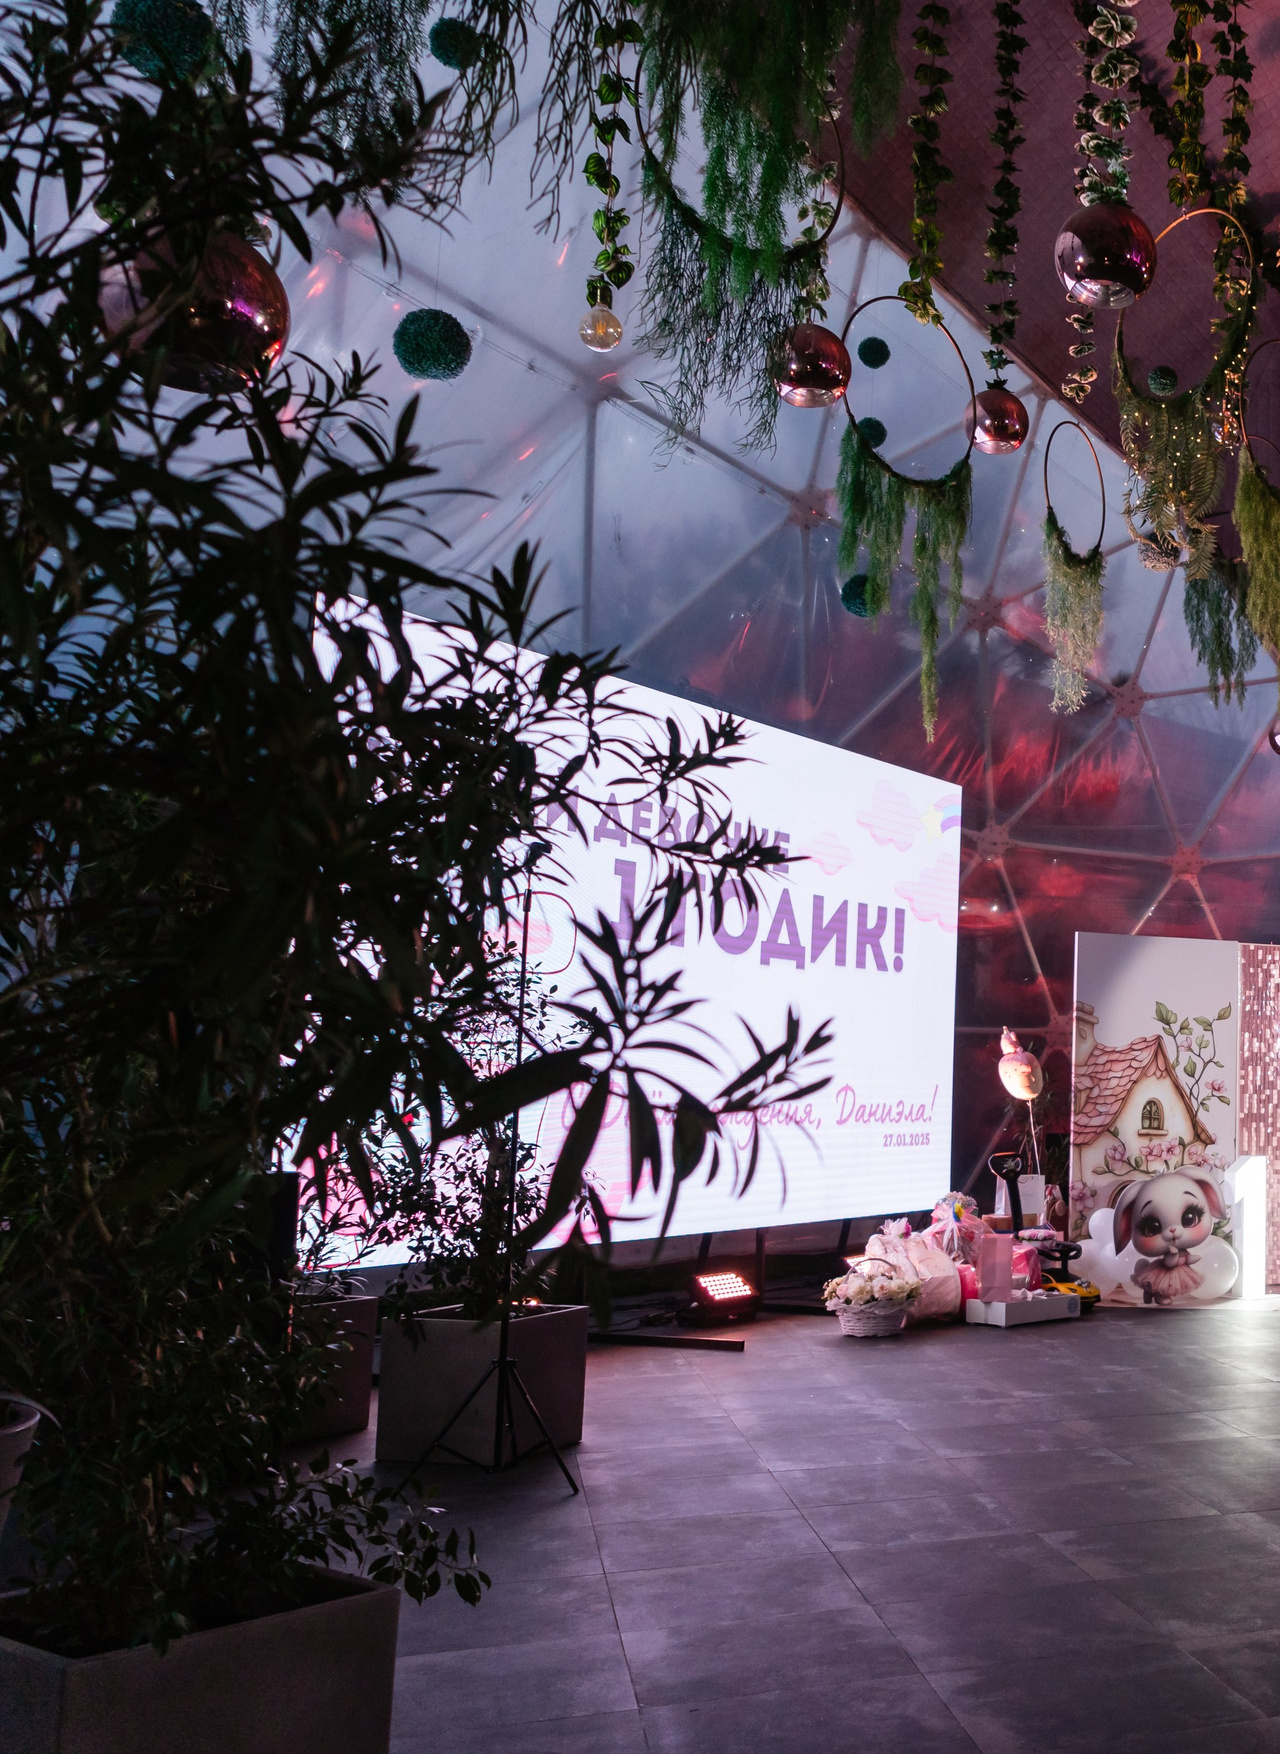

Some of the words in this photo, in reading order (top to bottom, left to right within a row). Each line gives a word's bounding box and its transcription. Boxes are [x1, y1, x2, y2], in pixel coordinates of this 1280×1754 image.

[593, 792, 790, 874] ДЕВОЧЕ
[611, 858, 641, 942] 1
[670, 869, 905, 973] ГОДИК!
[836, 1083, 939, 1126] Даниэла!
[883, 1132, 931, 1148] 27.01.2025
